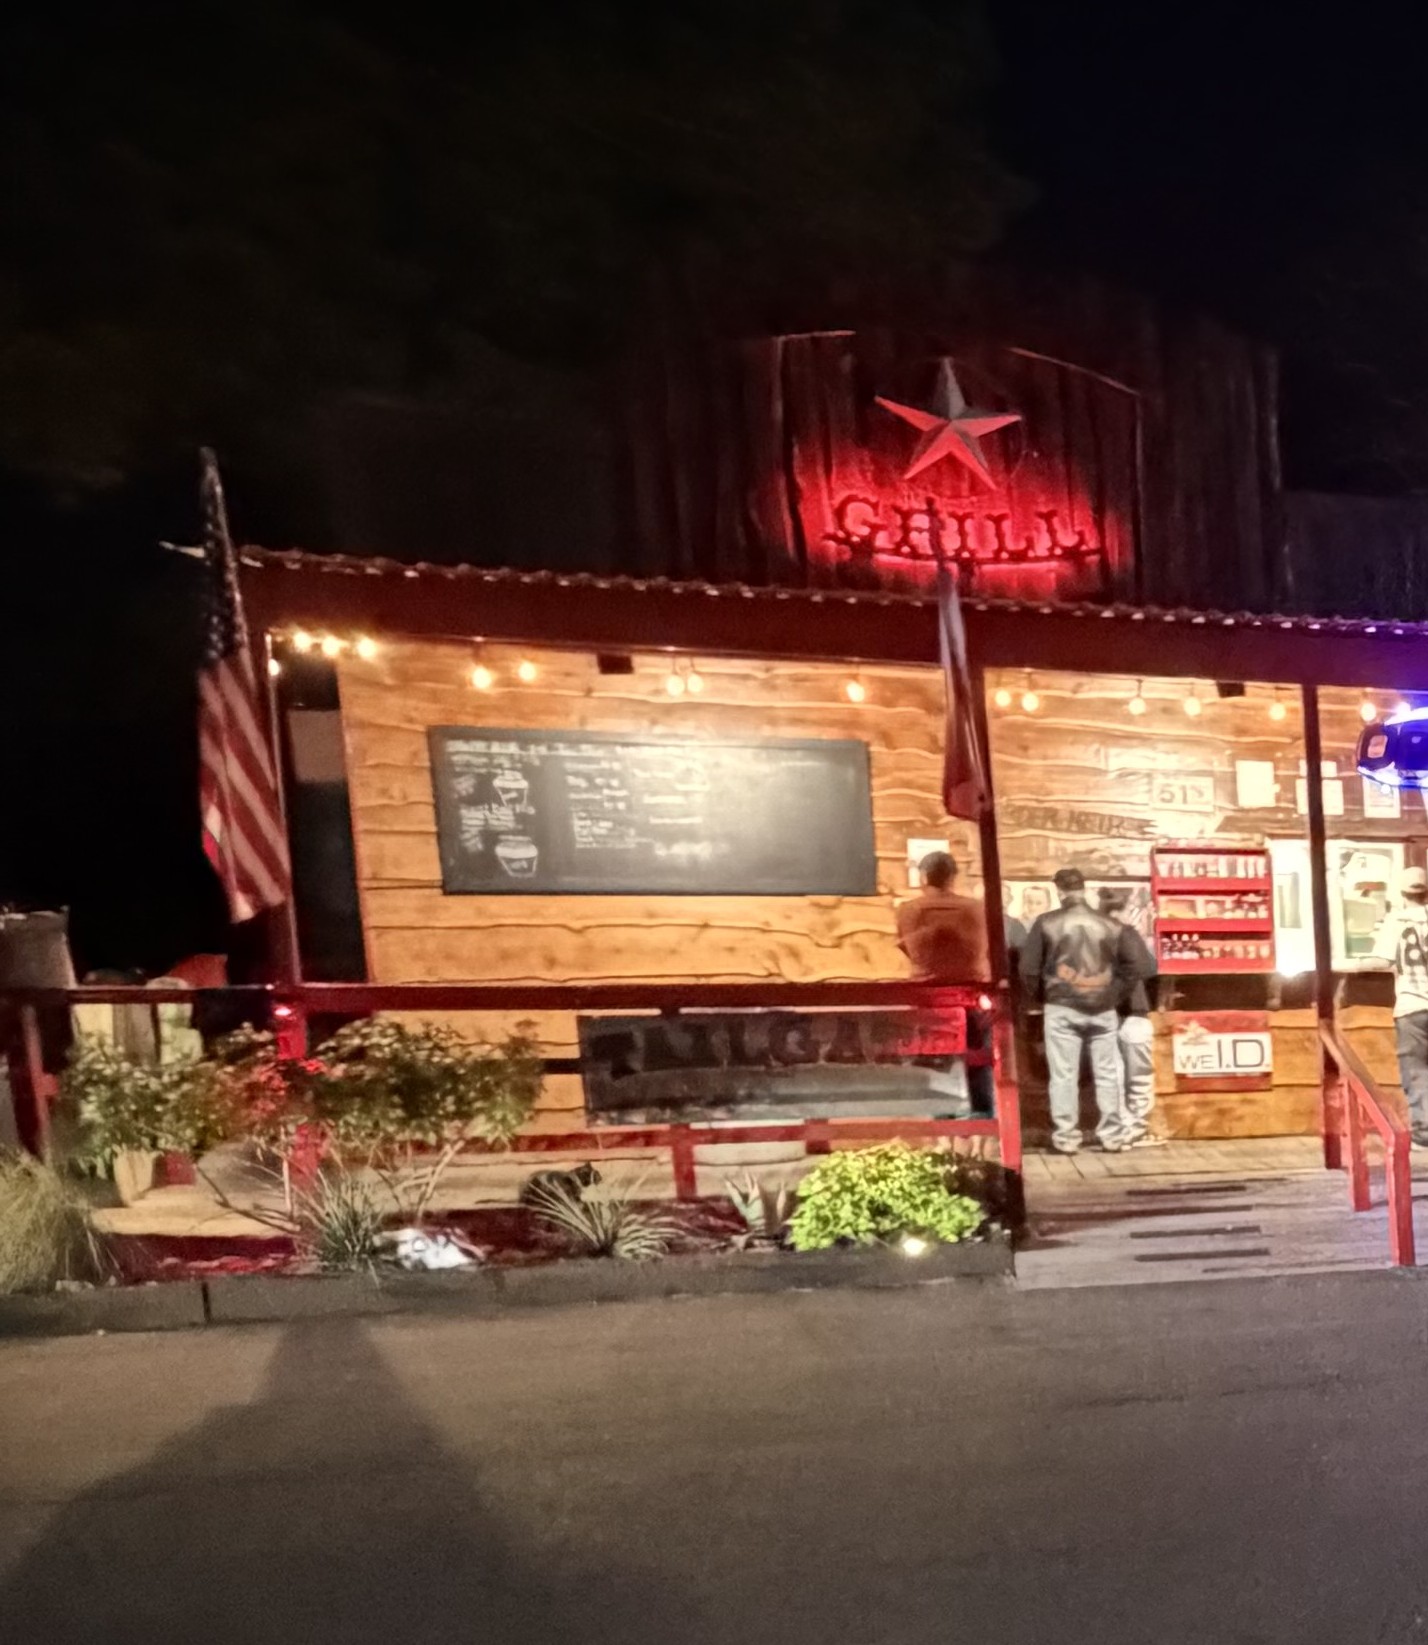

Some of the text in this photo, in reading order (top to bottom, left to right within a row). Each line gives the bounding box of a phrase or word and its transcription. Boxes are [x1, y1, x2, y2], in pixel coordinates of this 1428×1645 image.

[838, 494, 1088, 558] GRILL
[1180, 1038, 1270, 1070] WE I.D.
